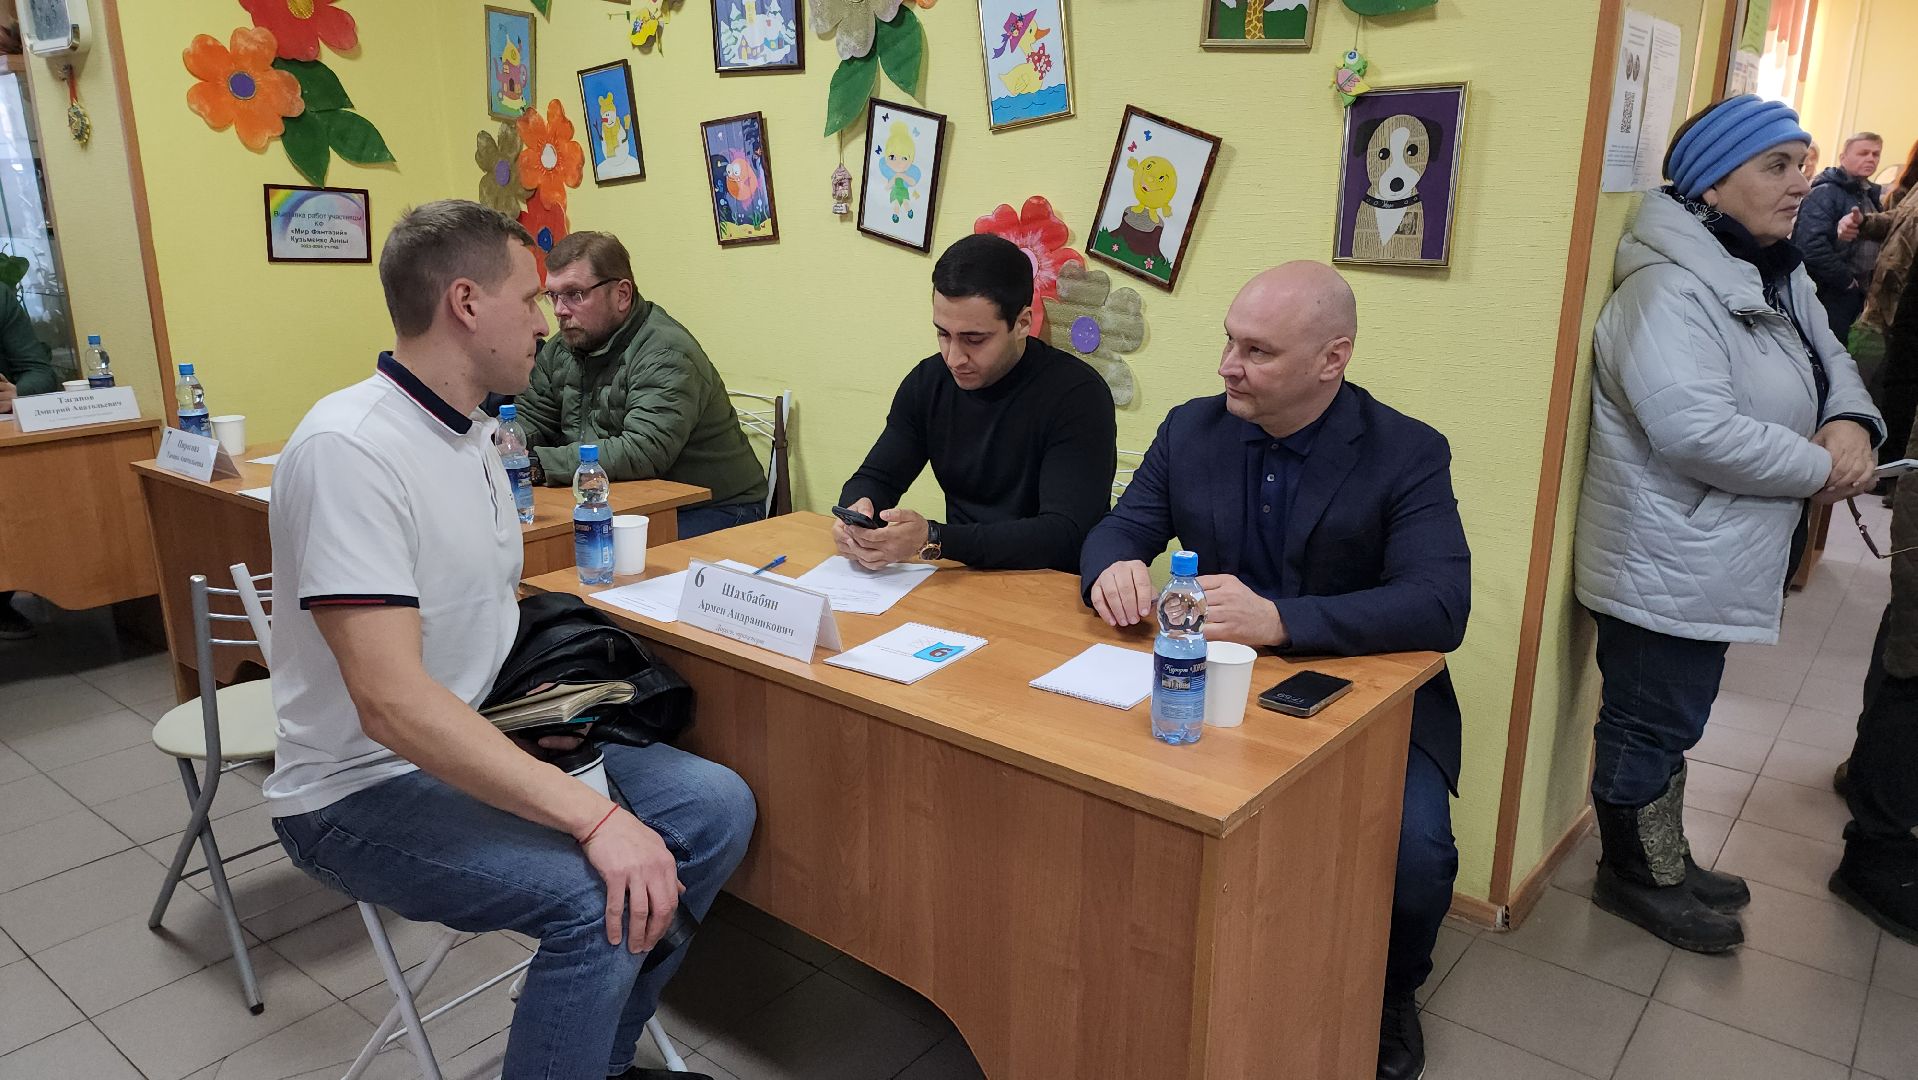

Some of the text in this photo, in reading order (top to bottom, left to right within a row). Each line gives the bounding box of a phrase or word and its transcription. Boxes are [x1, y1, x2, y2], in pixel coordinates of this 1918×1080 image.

[308, 212, 326, 220] работ
[329, 213, 361, 221] участницы
[34, 407, 71, 417] Дмитрий
[73, 401, 122, 412] Анатольевич
[694, 567, 707, 587] 6
[721, 582, 779, 611] Шахбабян
[698, 599, 726, 616] Армен
[727, 608, 794, 637] Андраникович
